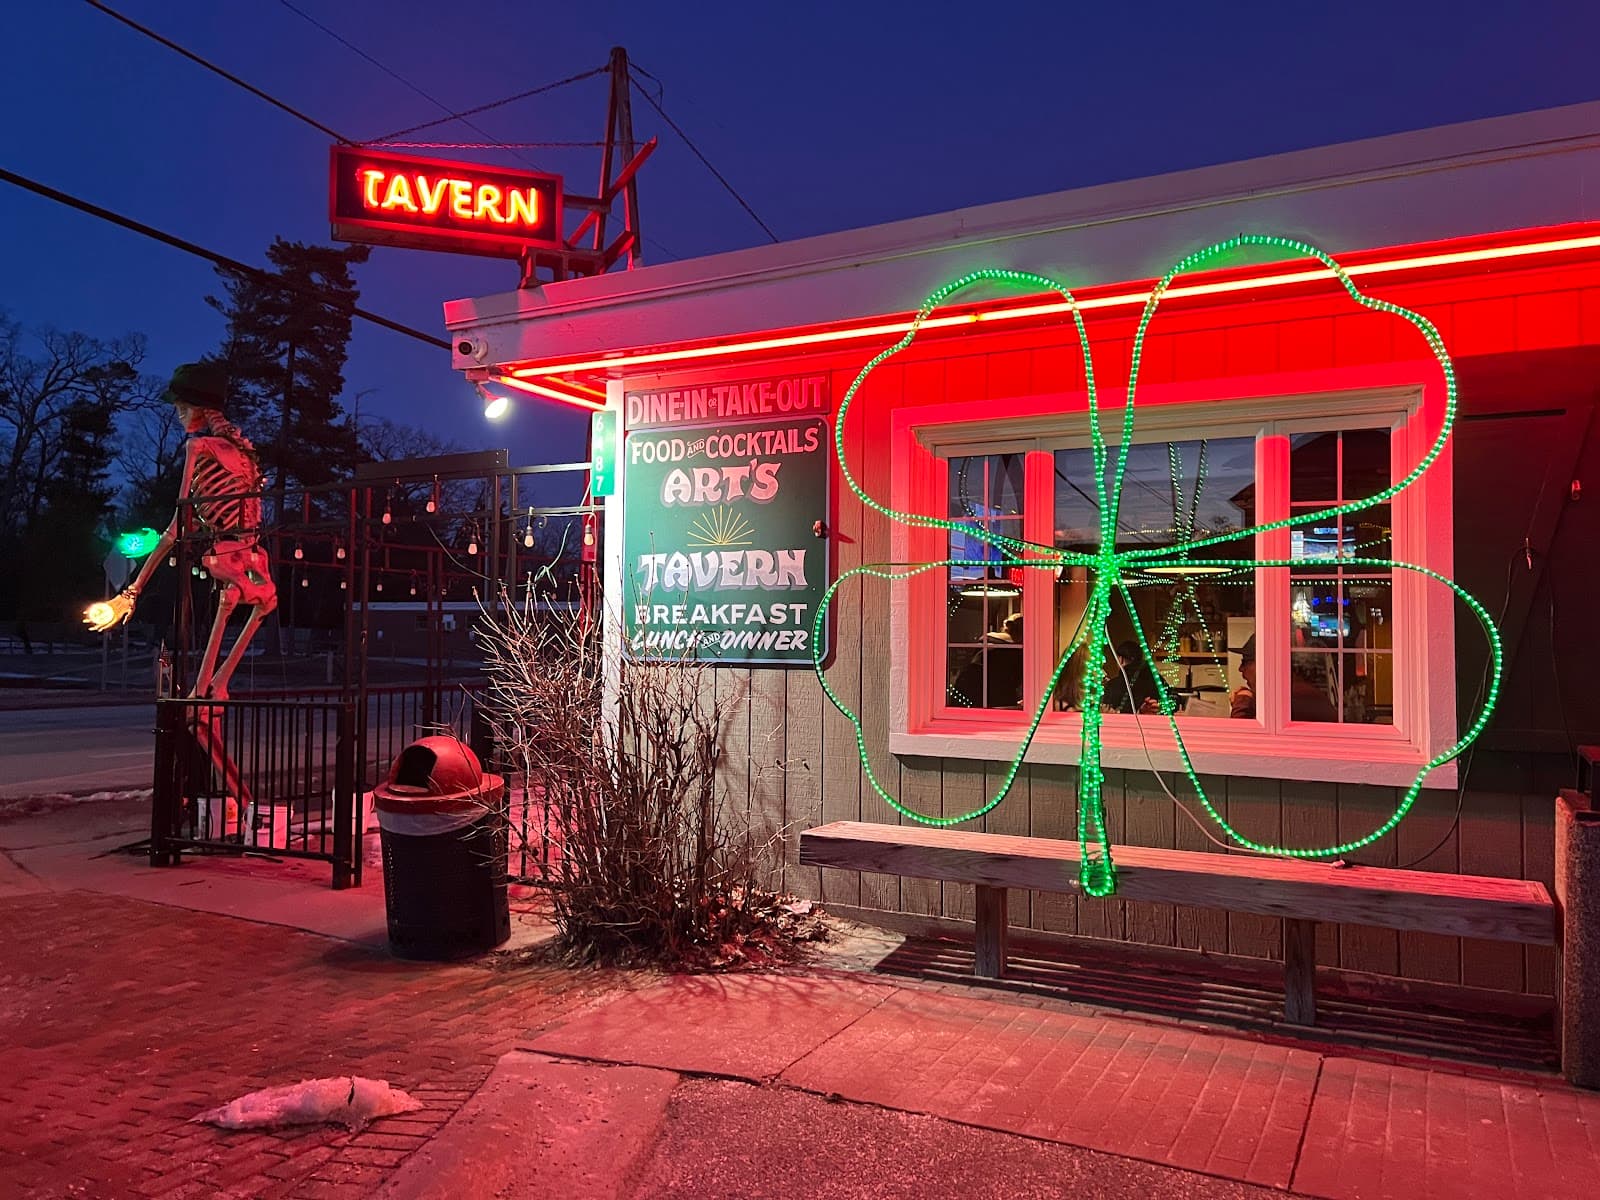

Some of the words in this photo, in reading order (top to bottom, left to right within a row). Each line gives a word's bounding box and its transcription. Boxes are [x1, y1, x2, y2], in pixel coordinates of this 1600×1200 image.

[361, 169, 539, 224] TAVERN
[628, 387, 708, 425] DINE-IN
[712, 376, 825, 417] TAKE-OUT
[631, 438, 686, 465] FOOD
[687, 440, 705, 456] AND
[706, 427, 819, 459] COCKTAILS
[662, 459, 782, 506] ART'S
[638, 549, 808, 592] TAVERN
[635, 604, 808, 625] BREAKFAST
[632, 629, 704, 651] LUNCH
[703, 632, 720, 646] AND
[720, 630, 808, 651] DINNER
